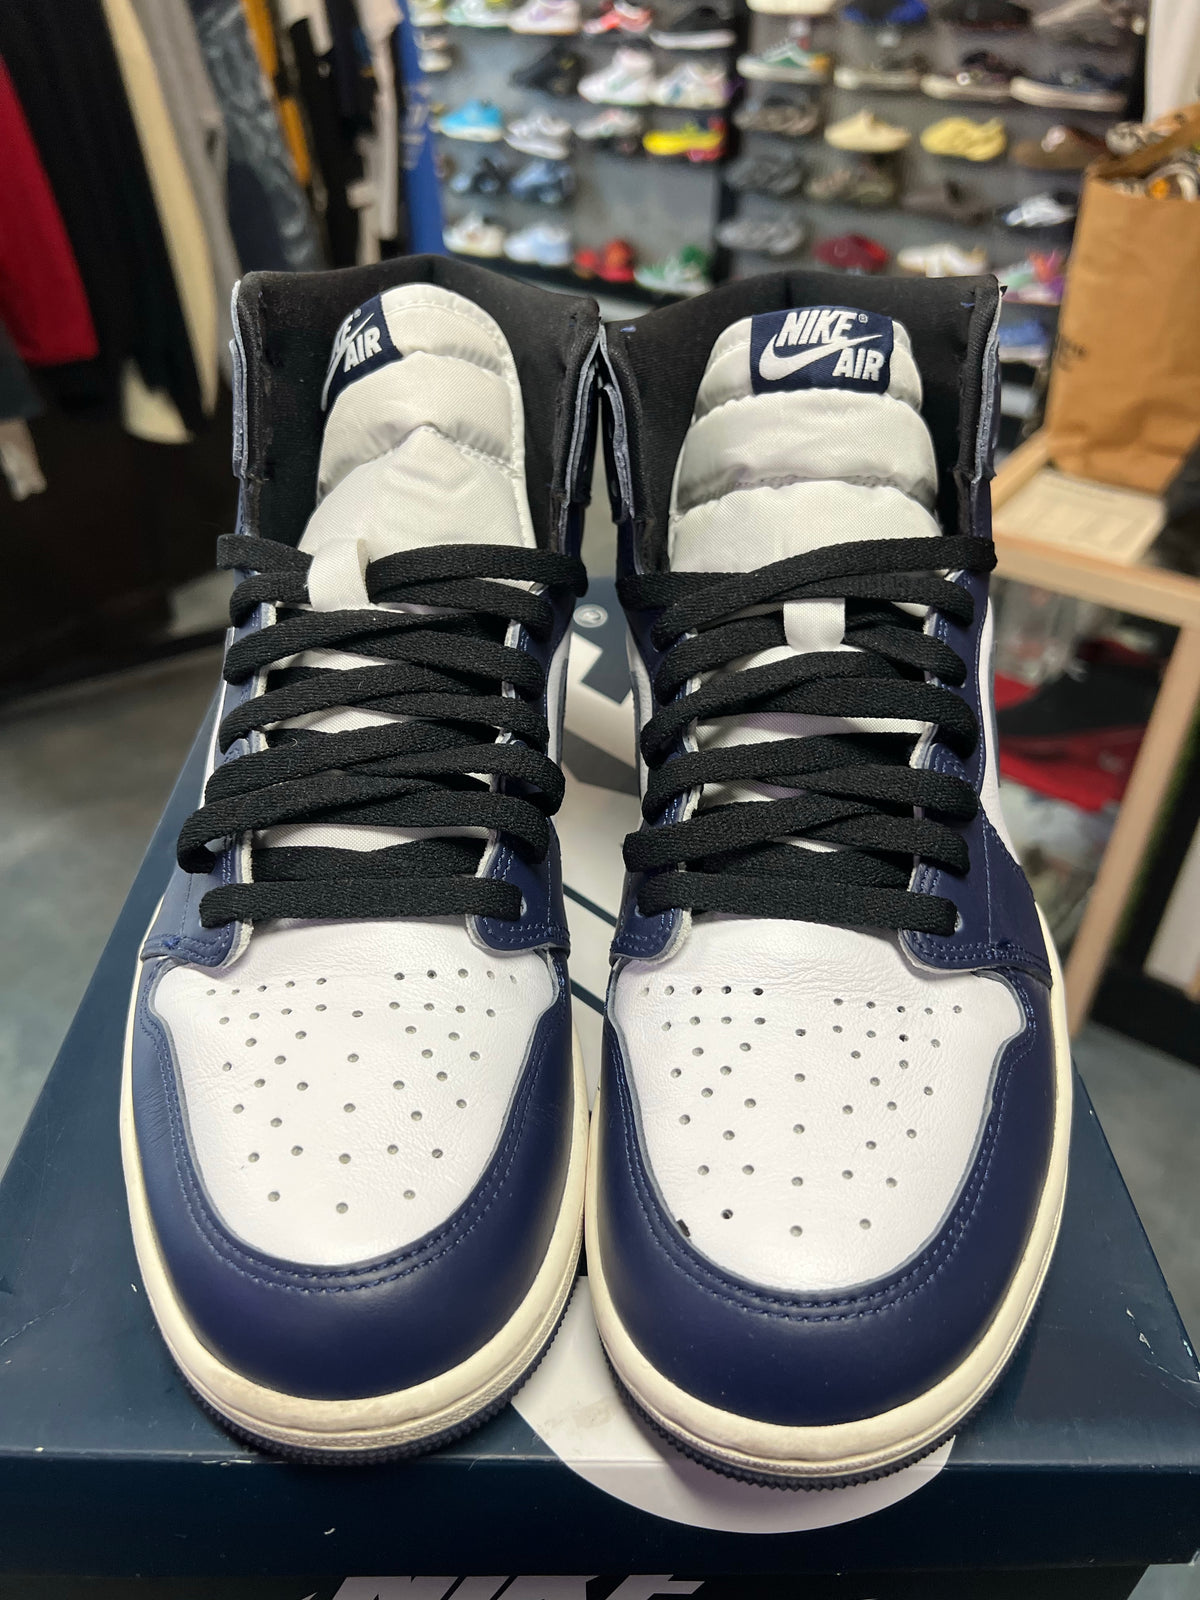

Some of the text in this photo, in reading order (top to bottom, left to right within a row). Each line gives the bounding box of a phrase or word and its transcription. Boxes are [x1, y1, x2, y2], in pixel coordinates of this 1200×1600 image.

[775, 310, 857, 347] NIKE
[343, 326, 383, 373] AIR
[832, 348, 884, 382] AIR
